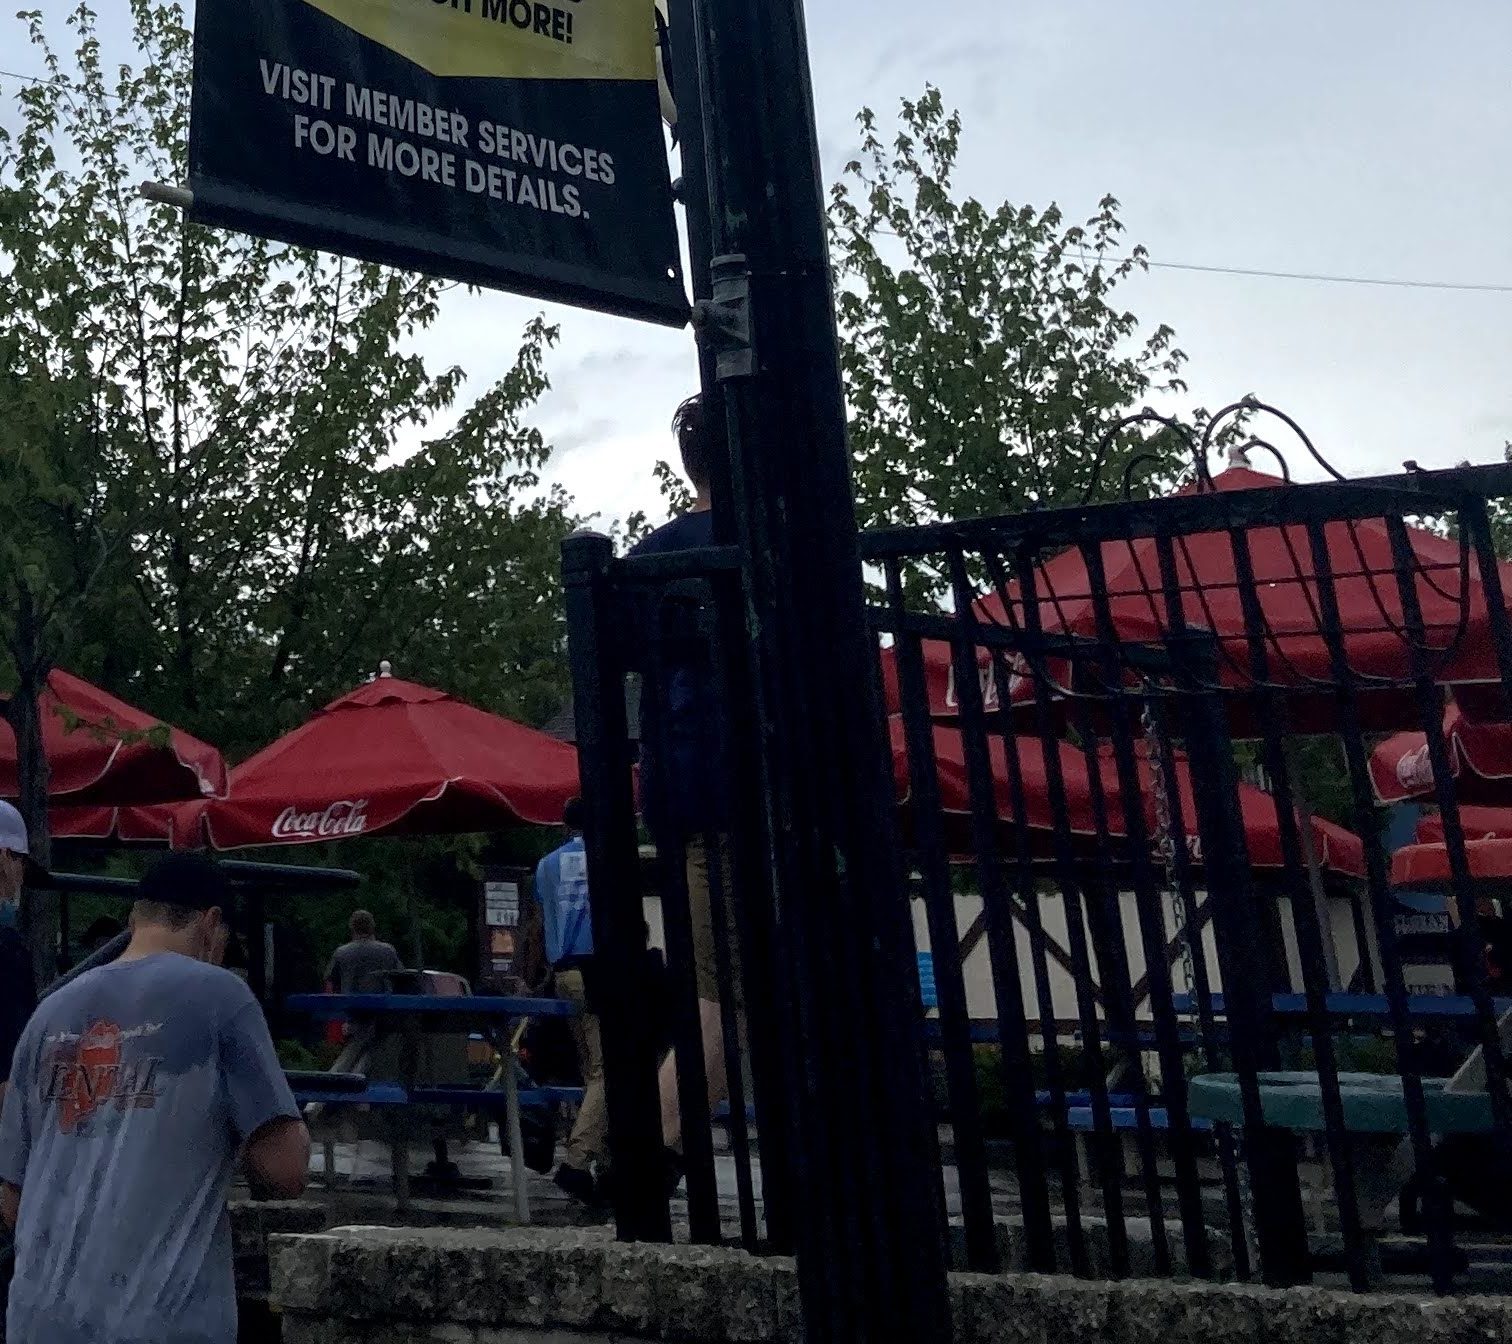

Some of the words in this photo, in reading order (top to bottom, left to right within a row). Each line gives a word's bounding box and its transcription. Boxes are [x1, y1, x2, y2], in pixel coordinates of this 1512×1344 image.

[259, 58, 336, 110] VISIT
[345, 84, 469, 148] MEMBER
[478, 119, 616, 185] SERVICES
[294, 114, 356, 161] FOR
[367, 136, 456, 187] MORE
[465, 159, 590, 220] DETAILS.
[271, 798, 369, 838] Coca-Cola
